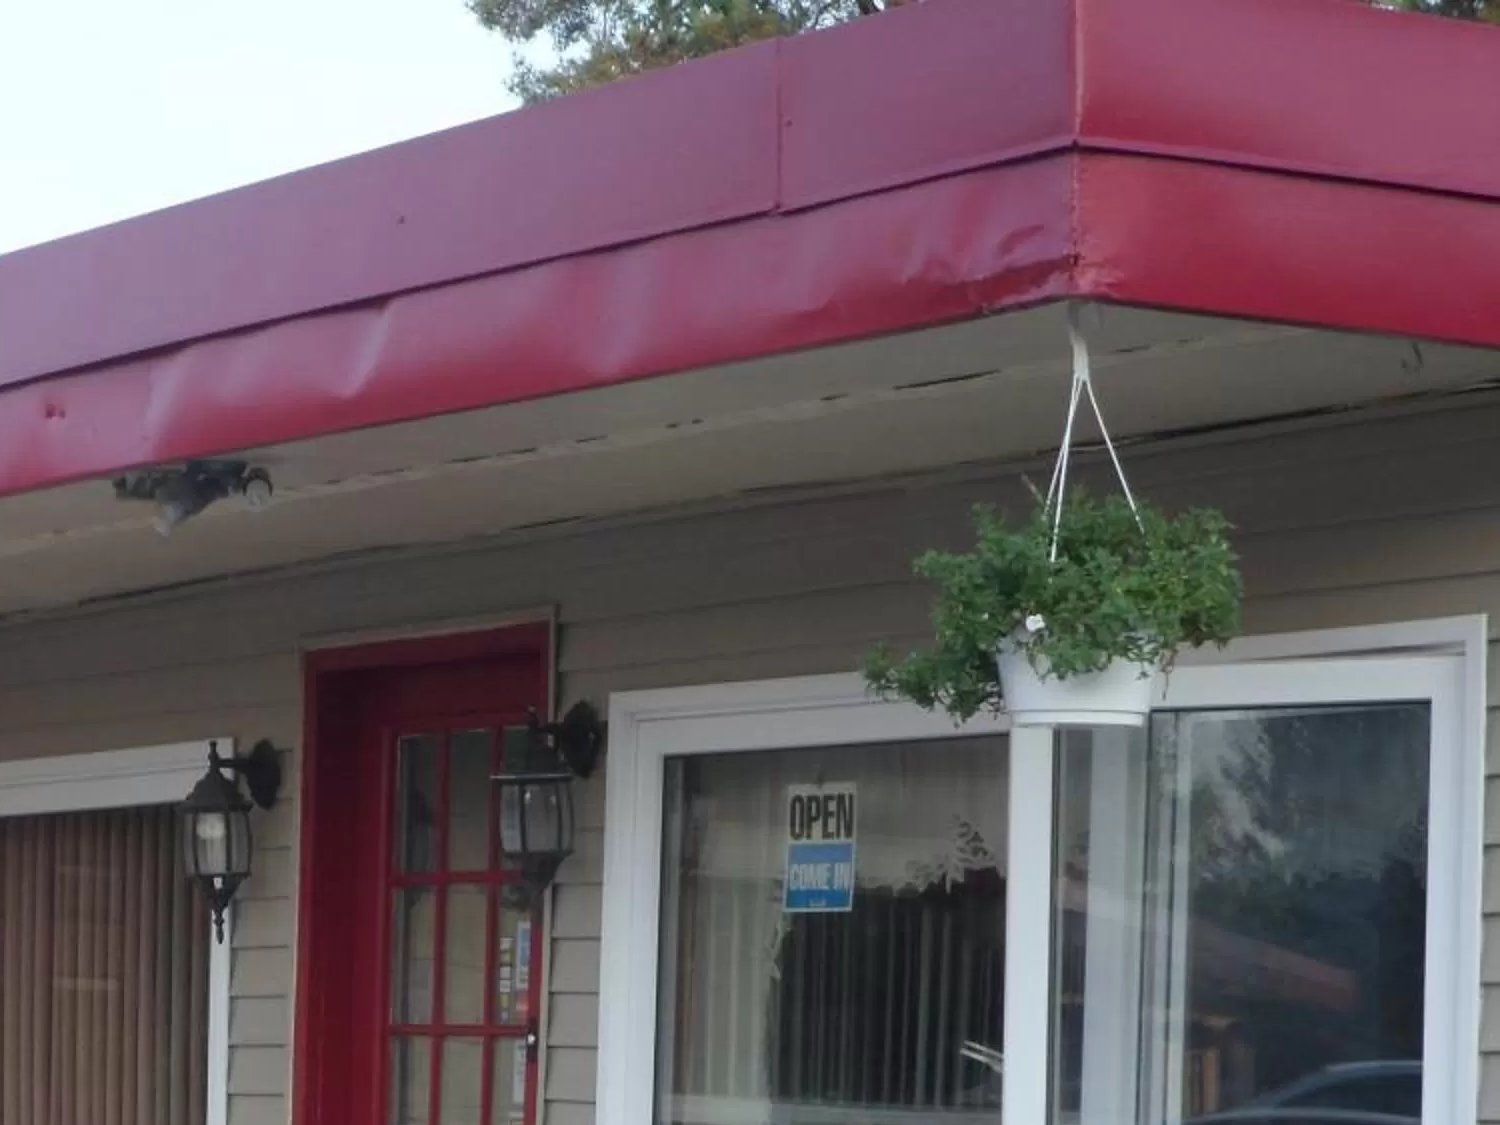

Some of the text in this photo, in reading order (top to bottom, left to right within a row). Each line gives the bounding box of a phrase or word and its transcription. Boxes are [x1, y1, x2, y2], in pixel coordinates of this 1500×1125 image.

[789, 792, 854, 841] OPEN
[789, 862, 852, 893] COME IN
